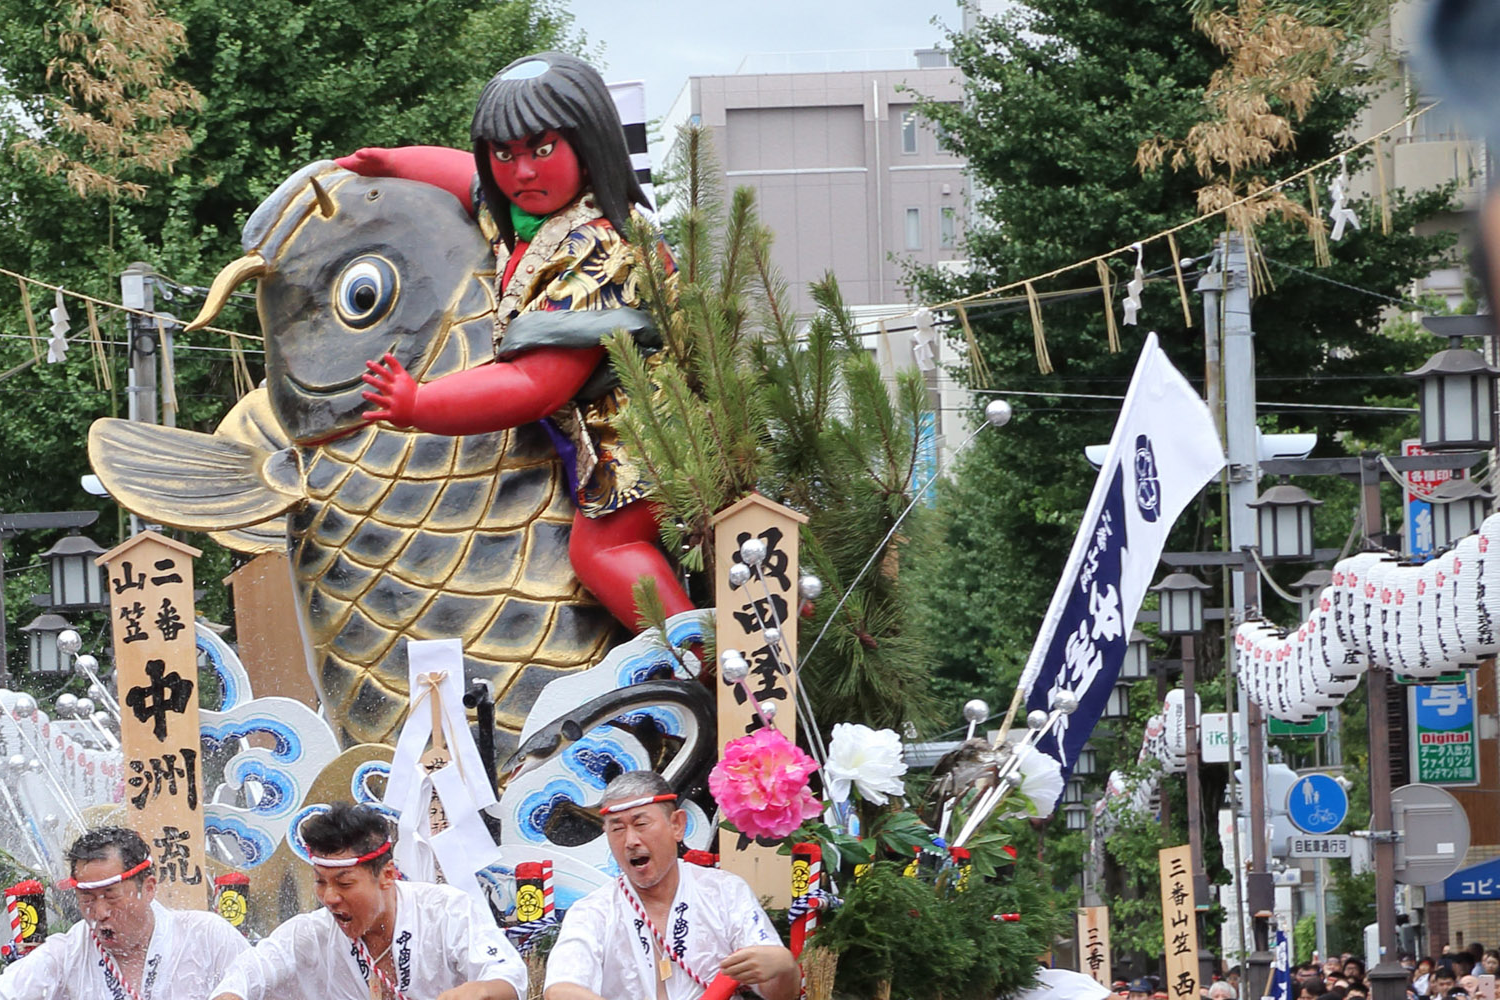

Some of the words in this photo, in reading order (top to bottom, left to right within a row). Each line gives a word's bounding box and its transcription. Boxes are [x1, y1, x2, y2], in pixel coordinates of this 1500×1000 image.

[112, 561, 149, 644] 山笠
[151, 558, 185, 642] 二番
[727, 526, 791, 851] 坂田怪
[1421, 732, 1470, 745] Digital
[1421, 744, 1472, 757] データ入出力
[1421, 756, 1472, 769] ファイリング
[1294, 839, 1348, 853] 自転車通行可
[1168, 858, 1192, 956] 三番山笠
